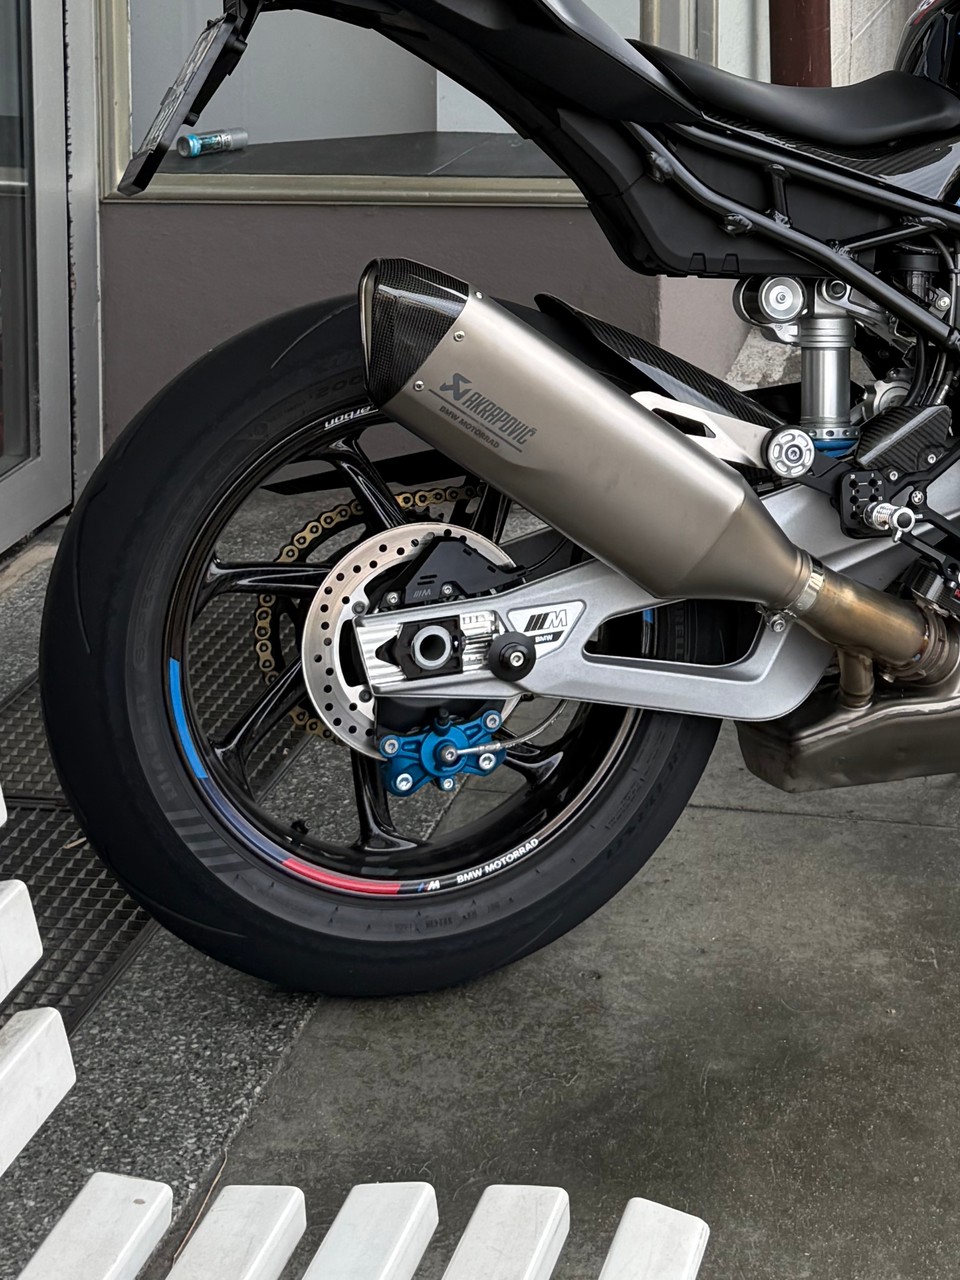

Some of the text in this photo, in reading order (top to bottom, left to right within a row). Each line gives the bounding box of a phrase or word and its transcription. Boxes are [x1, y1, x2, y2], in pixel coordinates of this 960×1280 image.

[323, 403, 378, 430] arbon
[439, 406, 500, 449] BMW MOTORRAD
[462, 391, 537, 445] AKRAPOVIČ
[535, 634, 553, 643] BMW
[456, 867, 483, 883] BMW
[484, 838, 539, 873] MOTORRAD
